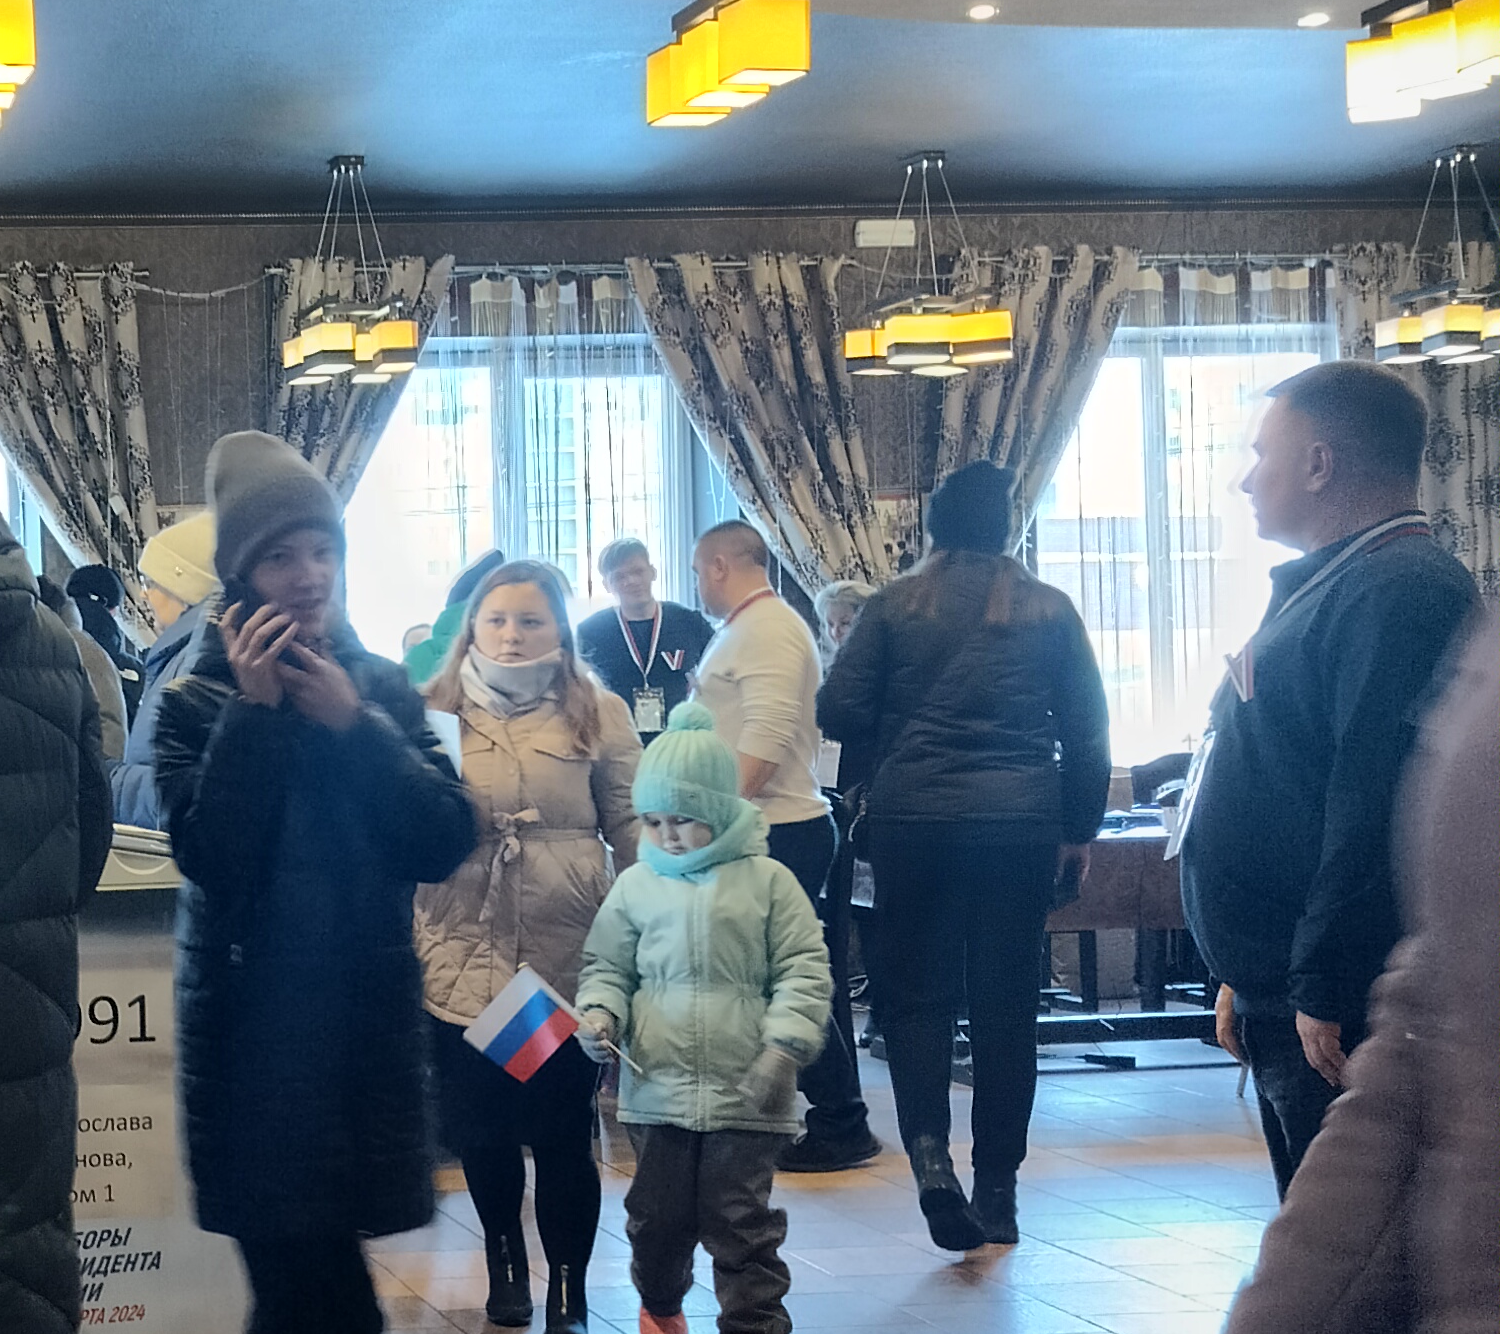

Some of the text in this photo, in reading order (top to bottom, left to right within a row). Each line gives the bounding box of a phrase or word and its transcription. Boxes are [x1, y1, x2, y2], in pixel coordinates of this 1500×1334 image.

[75, 994, 156, 1045] 91
[78, 1114, 153, 1133] ослава
[103, 1184, 115, 1202] 1
[81, 1251, 161, 1278] ИДЕНТА
[108, 1304, 145, 1323] 2024
